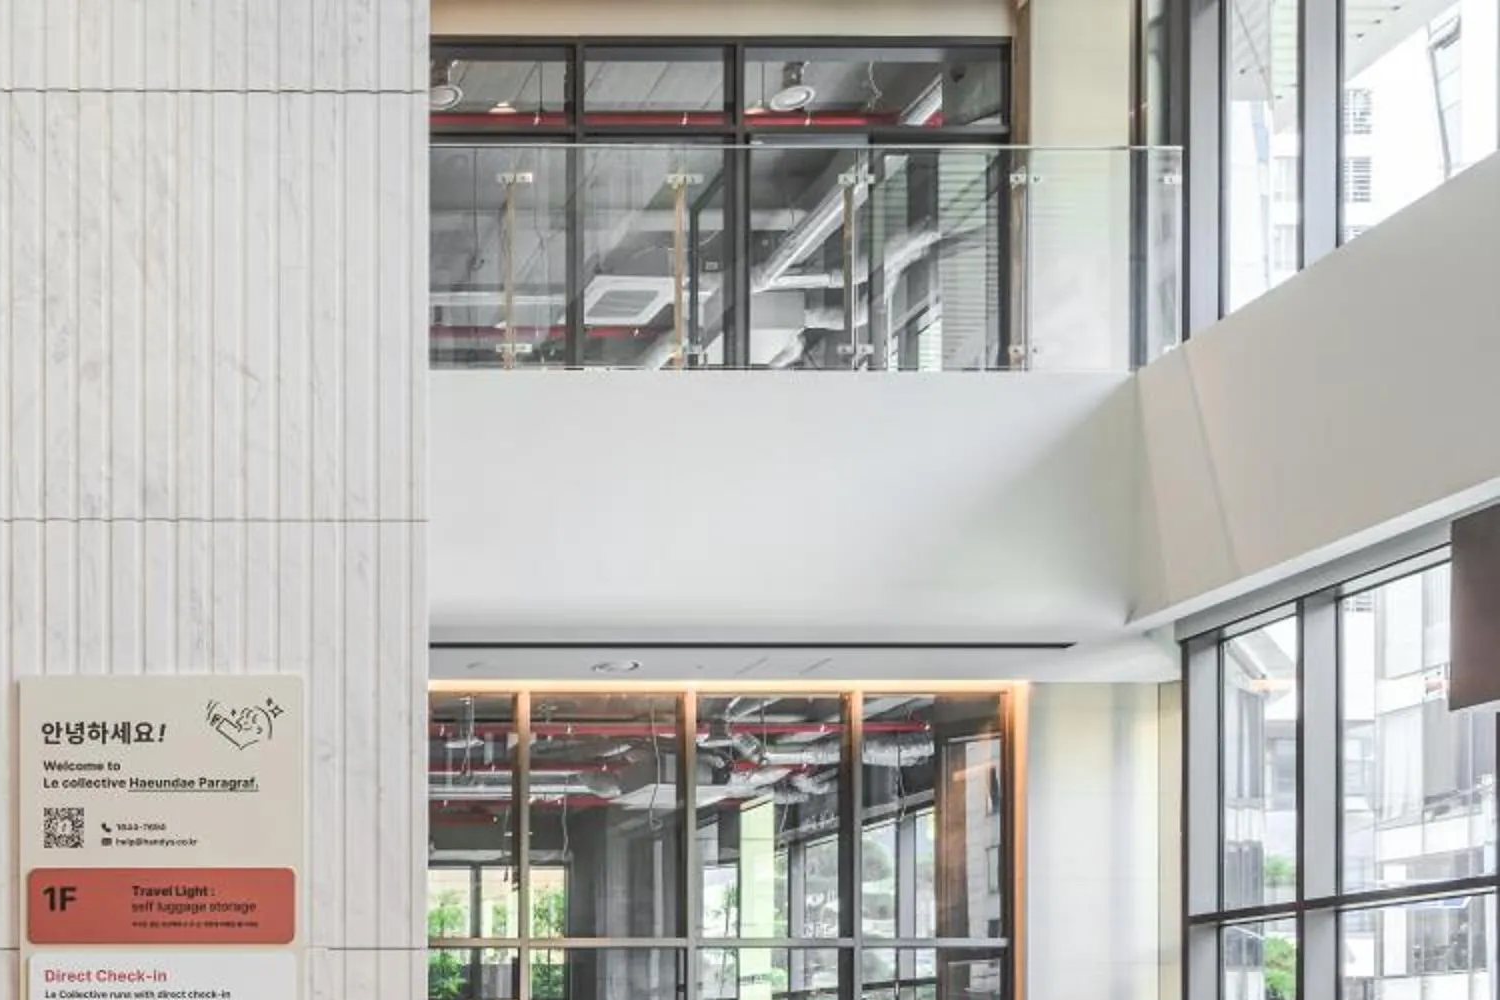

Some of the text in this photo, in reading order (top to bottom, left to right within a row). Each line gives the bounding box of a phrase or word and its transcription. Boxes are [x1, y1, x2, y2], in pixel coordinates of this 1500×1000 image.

[41, 722, 167, 745] 안녕하세요!
[43, 760, 121, 772] Welcome to
[43, 778, 59, 789] Le
[61, 777, 127, 789] collective
[129, 777, 196, 789] Haeundae
[42, 886, 77, 911] 1F
[131, 885, 173, 897] Travel
[174, 885, 209, 900] Light
[131, 901, 257, 915] self luggage storage
[43, 969, 168, 983] Direct Check-in
[44, 989, 231, 999] Le Collective runs with direct check-in
